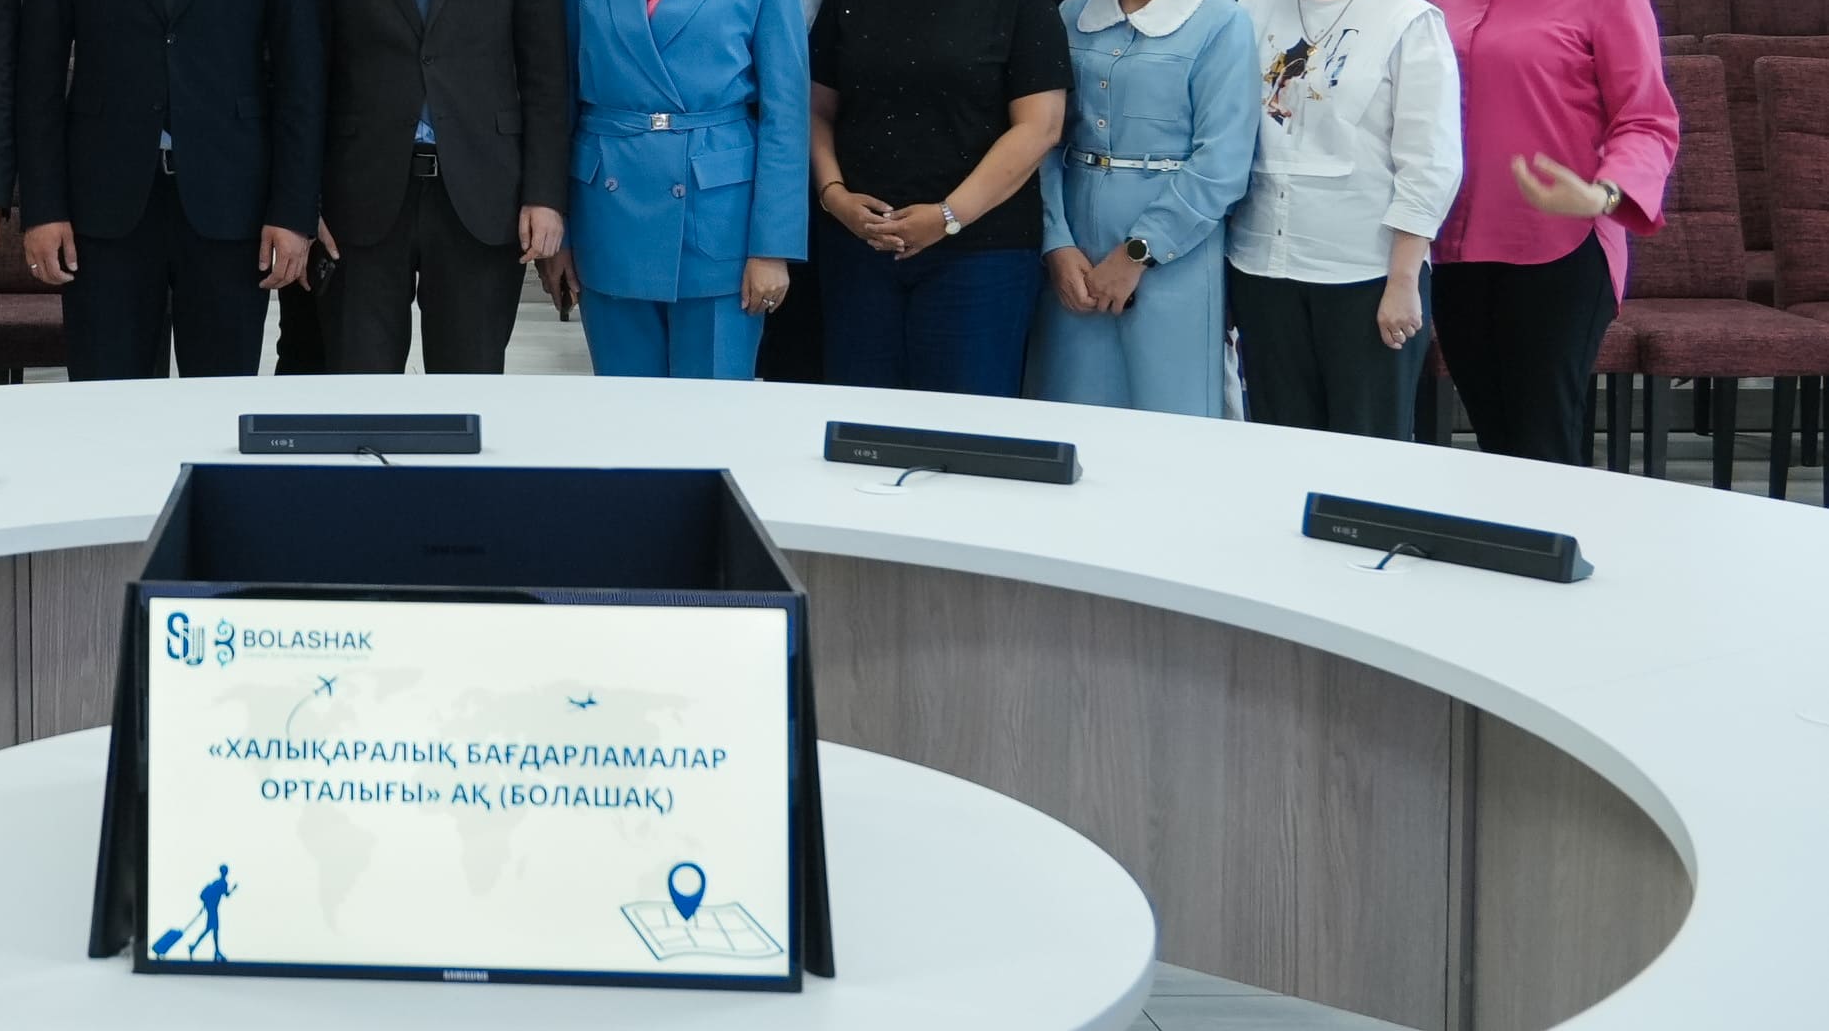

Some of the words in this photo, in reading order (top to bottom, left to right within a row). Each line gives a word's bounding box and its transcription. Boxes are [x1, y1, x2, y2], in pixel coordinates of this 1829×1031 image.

[243, 629, 373, 650] BOLASHAK
[208, 737, 458, 769] «ХАЛЫҚАРАЛЫҚ
[467, 744, 728, 770] БАҒДАРЛАМАЛАР
[260, 779, 441, 803] ОРТАЛЫҒЫ»
[451, 784, 491, 810] АҚ
[499, 784, 674, 815] (БОЛАШАҚ)
